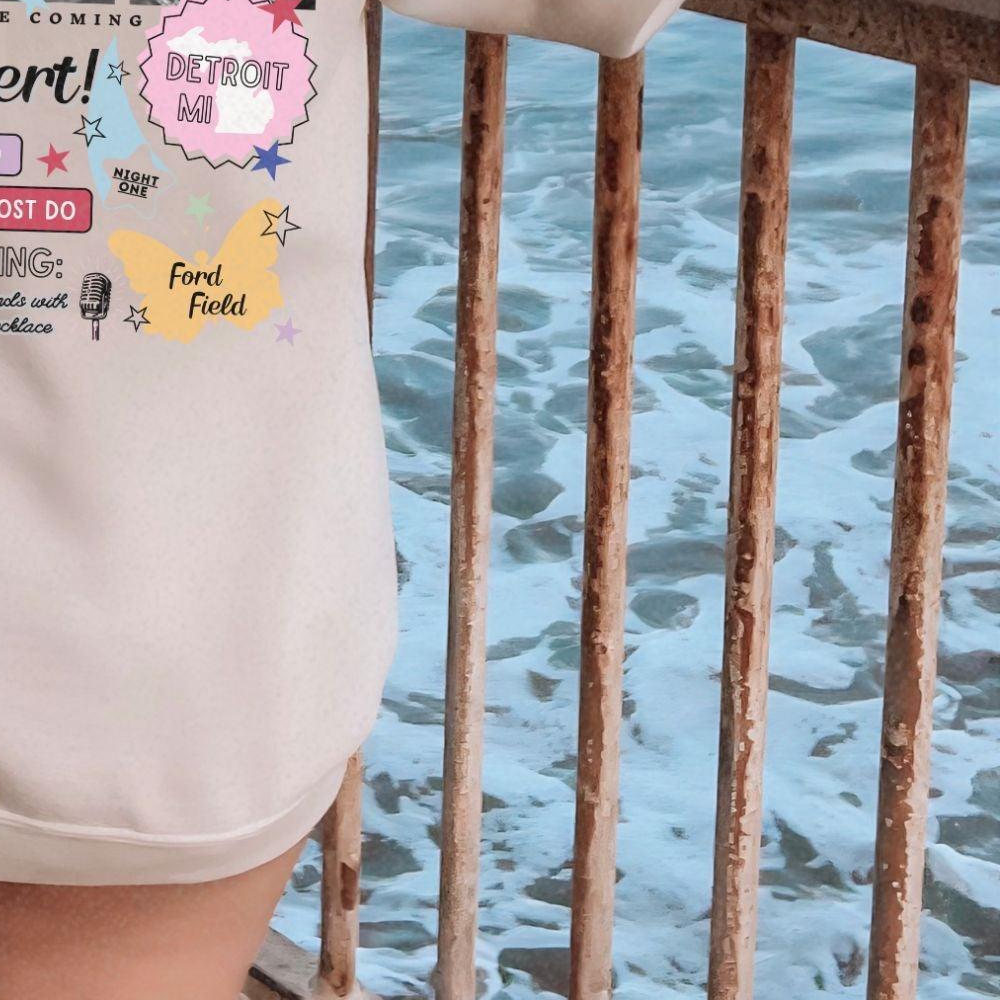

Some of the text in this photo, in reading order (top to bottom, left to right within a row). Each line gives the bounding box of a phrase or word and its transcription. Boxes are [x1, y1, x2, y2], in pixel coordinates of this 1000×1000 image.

[29, 12, 144, 27] COMING
[166, 52, 290, 91] DETROIT
[177, 93, 212, 124] MI
[113, 167, 160, 187] NIGHT
[119, 181, 149, 196] ONE
[45, 201, 76, 221] DO
[168, 261, 223, 290] Ford
[30, 292, 68, 309] with
[188, 291, 248, 319] Field
